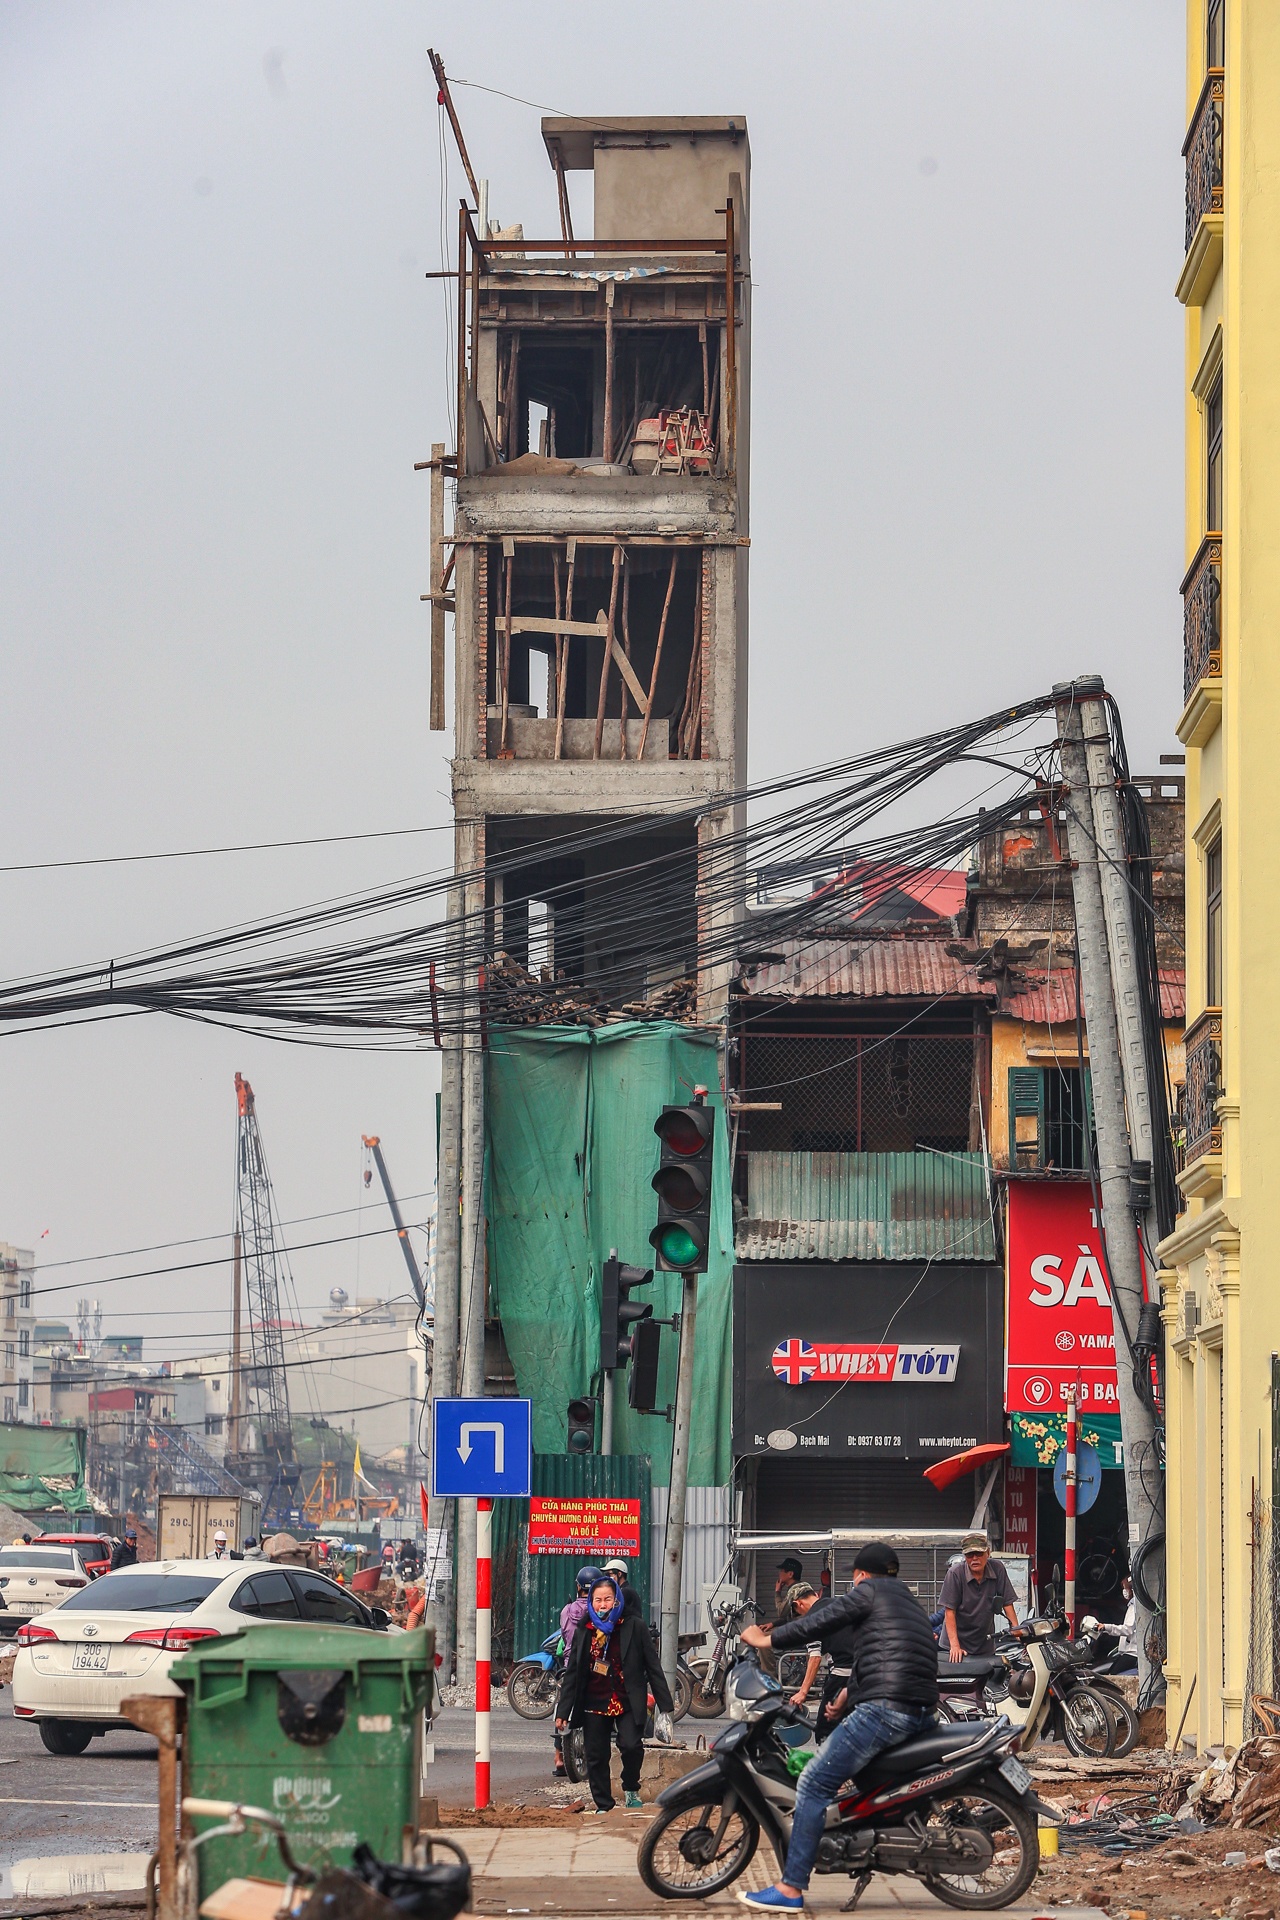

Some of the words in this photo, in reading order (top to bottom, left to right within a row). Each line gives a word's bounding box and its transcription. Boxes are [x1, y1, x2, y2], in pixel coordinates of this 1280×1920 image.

[819, 1353, 894, 1374] WHEY
[899, 1347, 955, 1375] TỐT
[800, 1435, 816, 1448] Bạch
[817, 1435, 830, 1446] Mai
[858, 1435, 874, 1446] 0937
[875, 1436, 883, 1446] 63
[884, 1436, 892, 1447] 07
[893, 1436, 902, 1447] 28
[918, 1436, 977, 1448] www.wheytot.com
[542, 1499, 558, 1510] CỬA
[561, 1501, 583, 1510] HÀNG
[585, 1501, 607, 1511] PHÚC
[610, 1502, 628, 1512] THÁI
[170, 1518, 181, 1527] 29
[207, 1518, 235, 1528] 454.18
[531, 1512, 557, 1523] CHUYÊN
[603, 1514, 621, 1524] BÁNH
[623, 1513, 638, 1524] CỐM
[1006, 1515, 1028, 1532] LÀM
[570, 1526, 579, 1536] VÀ
[83, 1643, 101, 1656] 30G
[75, 1656, 107, 1669] 194.42
